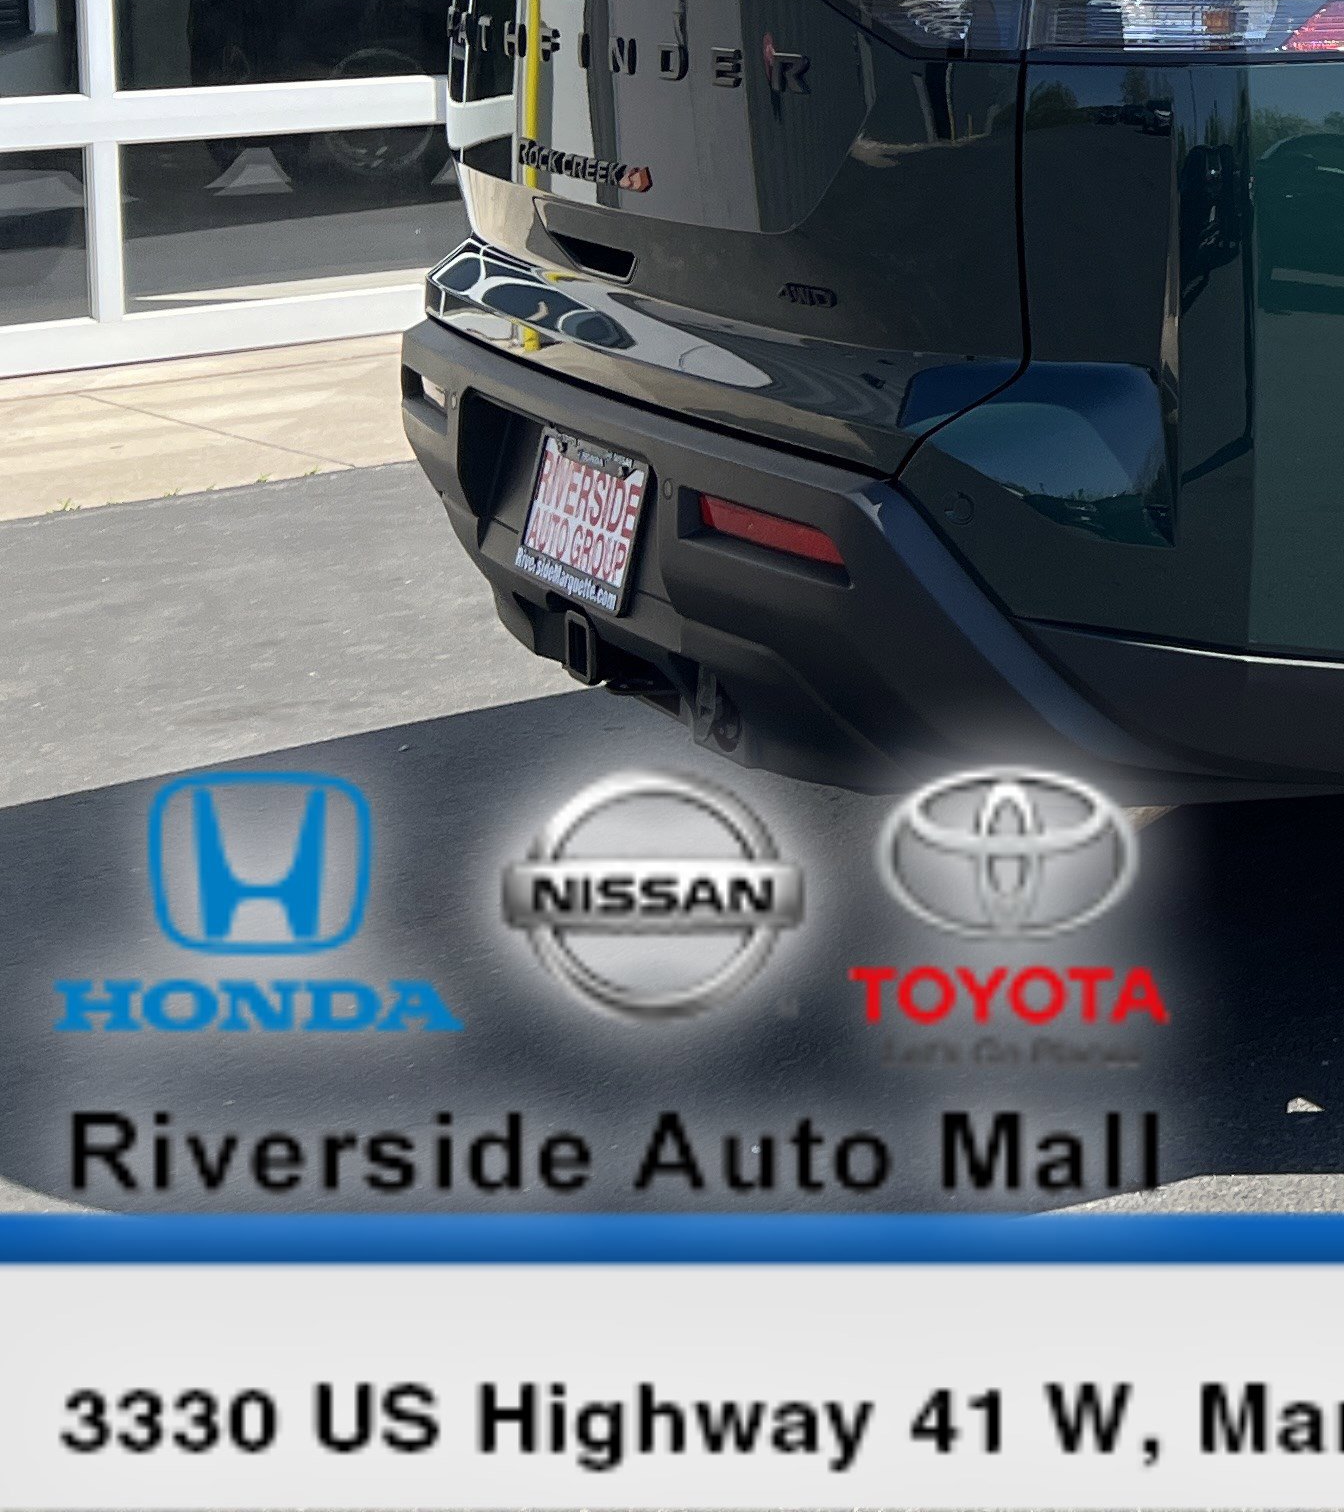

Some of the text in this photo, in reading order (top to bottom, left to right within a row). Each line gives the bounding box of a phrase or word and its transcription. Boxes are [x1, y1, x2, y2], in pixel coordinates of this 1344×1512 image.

[518, 138, 626, 186] ROCK CREEK
[538, 450, 642, 540] RIVERSIDE
[527, 508, 628, 581] AUTO GROUP
